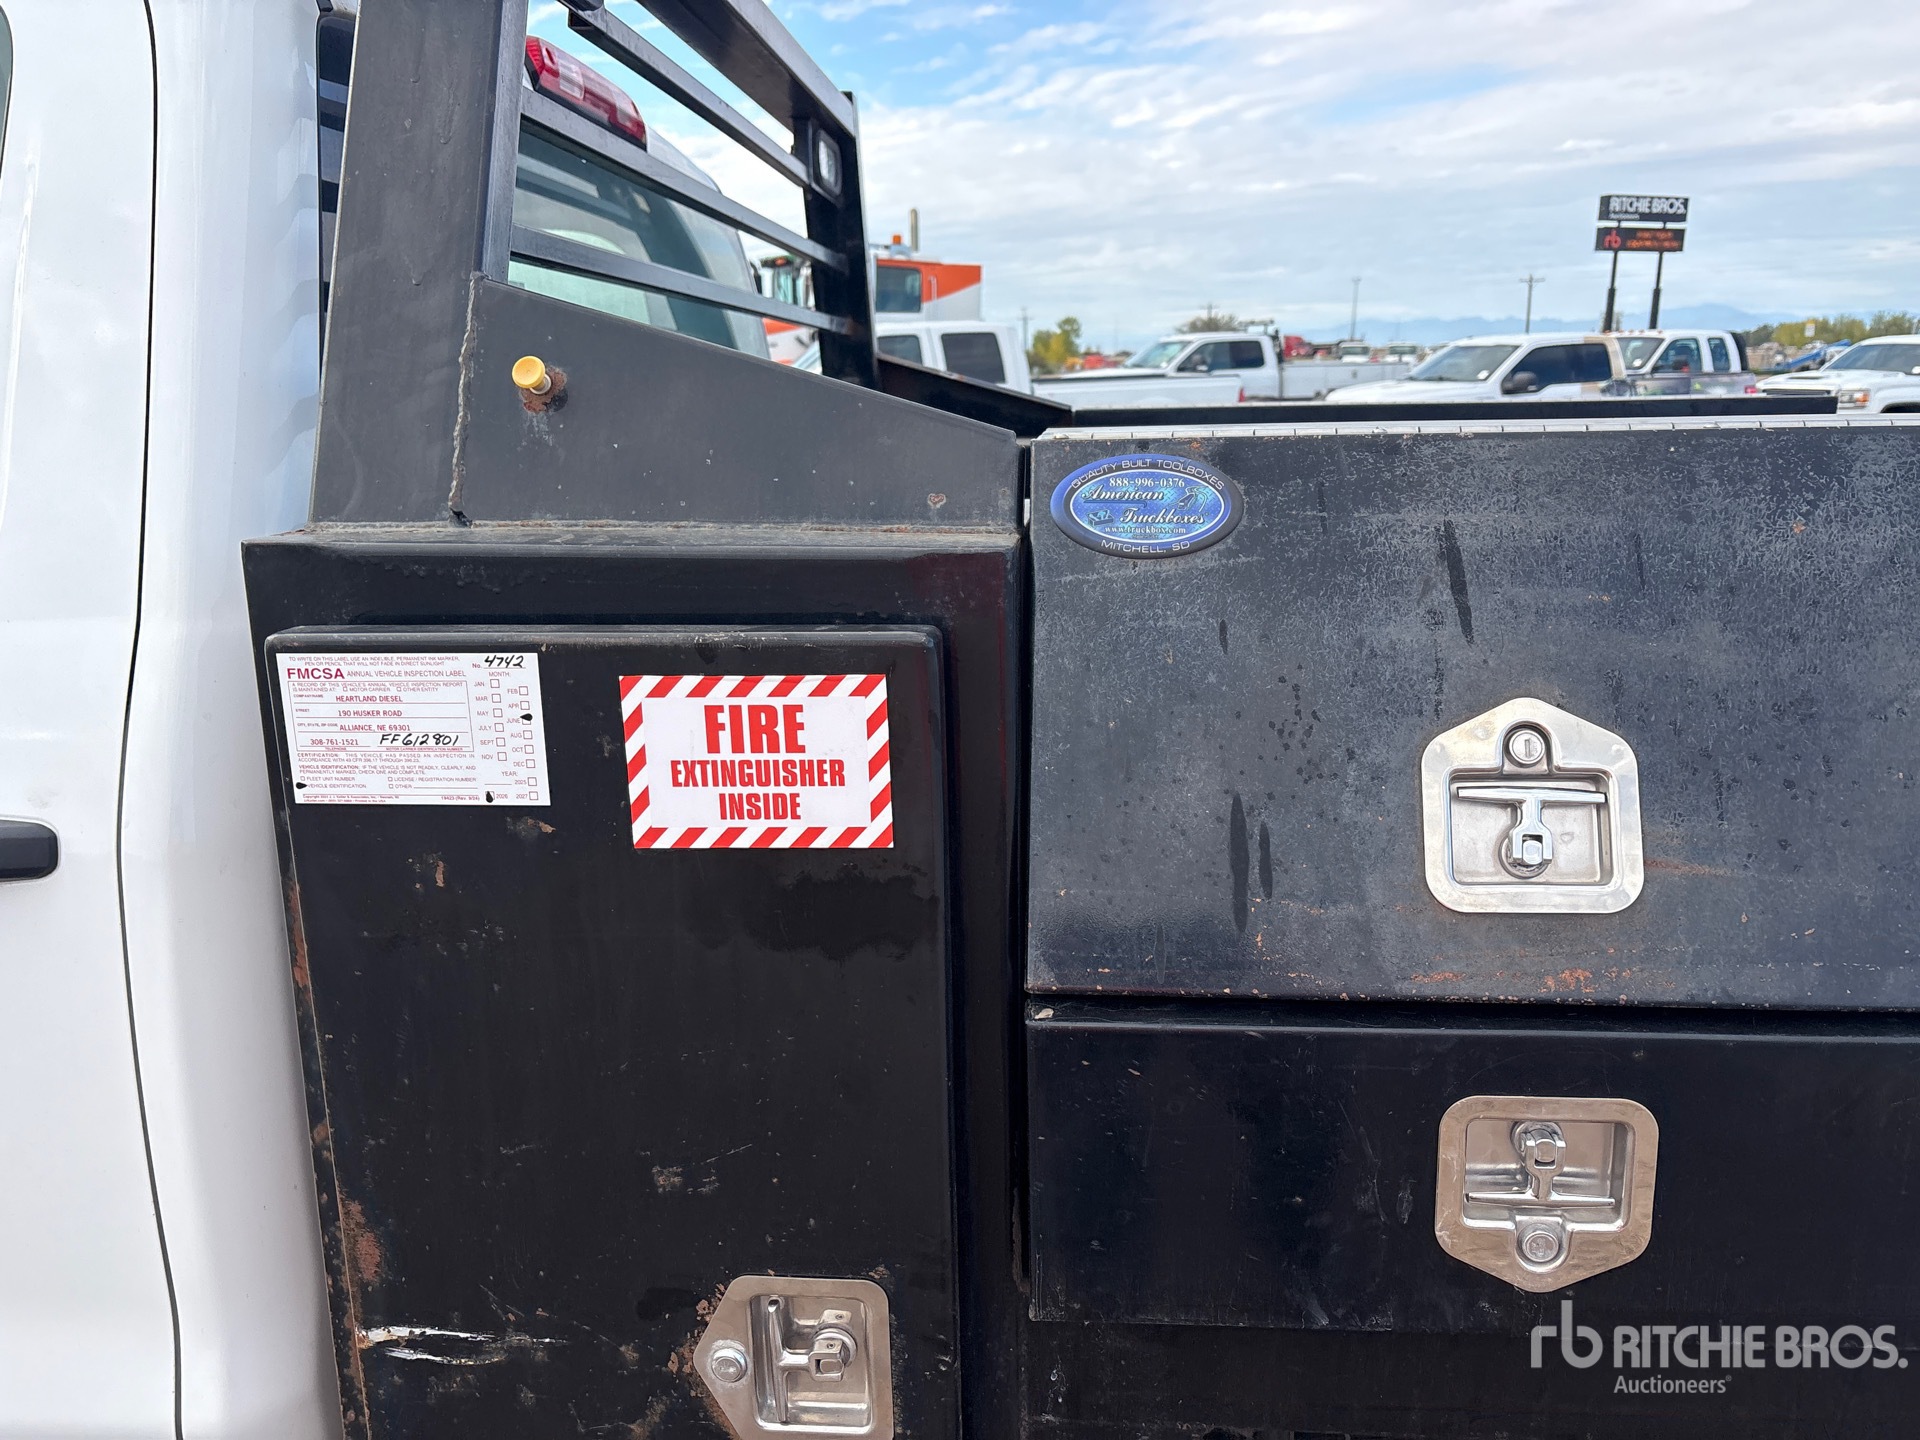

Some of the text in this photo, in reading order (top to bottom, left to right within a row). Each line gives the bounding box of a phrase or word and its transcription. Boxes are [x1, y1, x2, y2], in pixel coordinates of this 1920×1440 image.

[1609, 196, 1687, 215] RITCHIE BROS.
[1071, 458, 1225, 490] QUALITY BUILT TOOLBOXES
[1109, 477, 1185, 488] 888-996-0376
[1082, 484, 1164, 500] American
[1105, 525, 1186, 534] www.truckbox.com
[1101, 539, 1190, 554] MITCHELL, SD
[484, 654, 524, 668] 4742
[287, 667, 345, 679] FMCSA
[704, 704, 806, 754] FIRE
[310, 738, 359, 746] 308-761-1521
[670, 759, 846, 788] EXTINGUISHER
[718, 792, 802, 821] INSIDE
